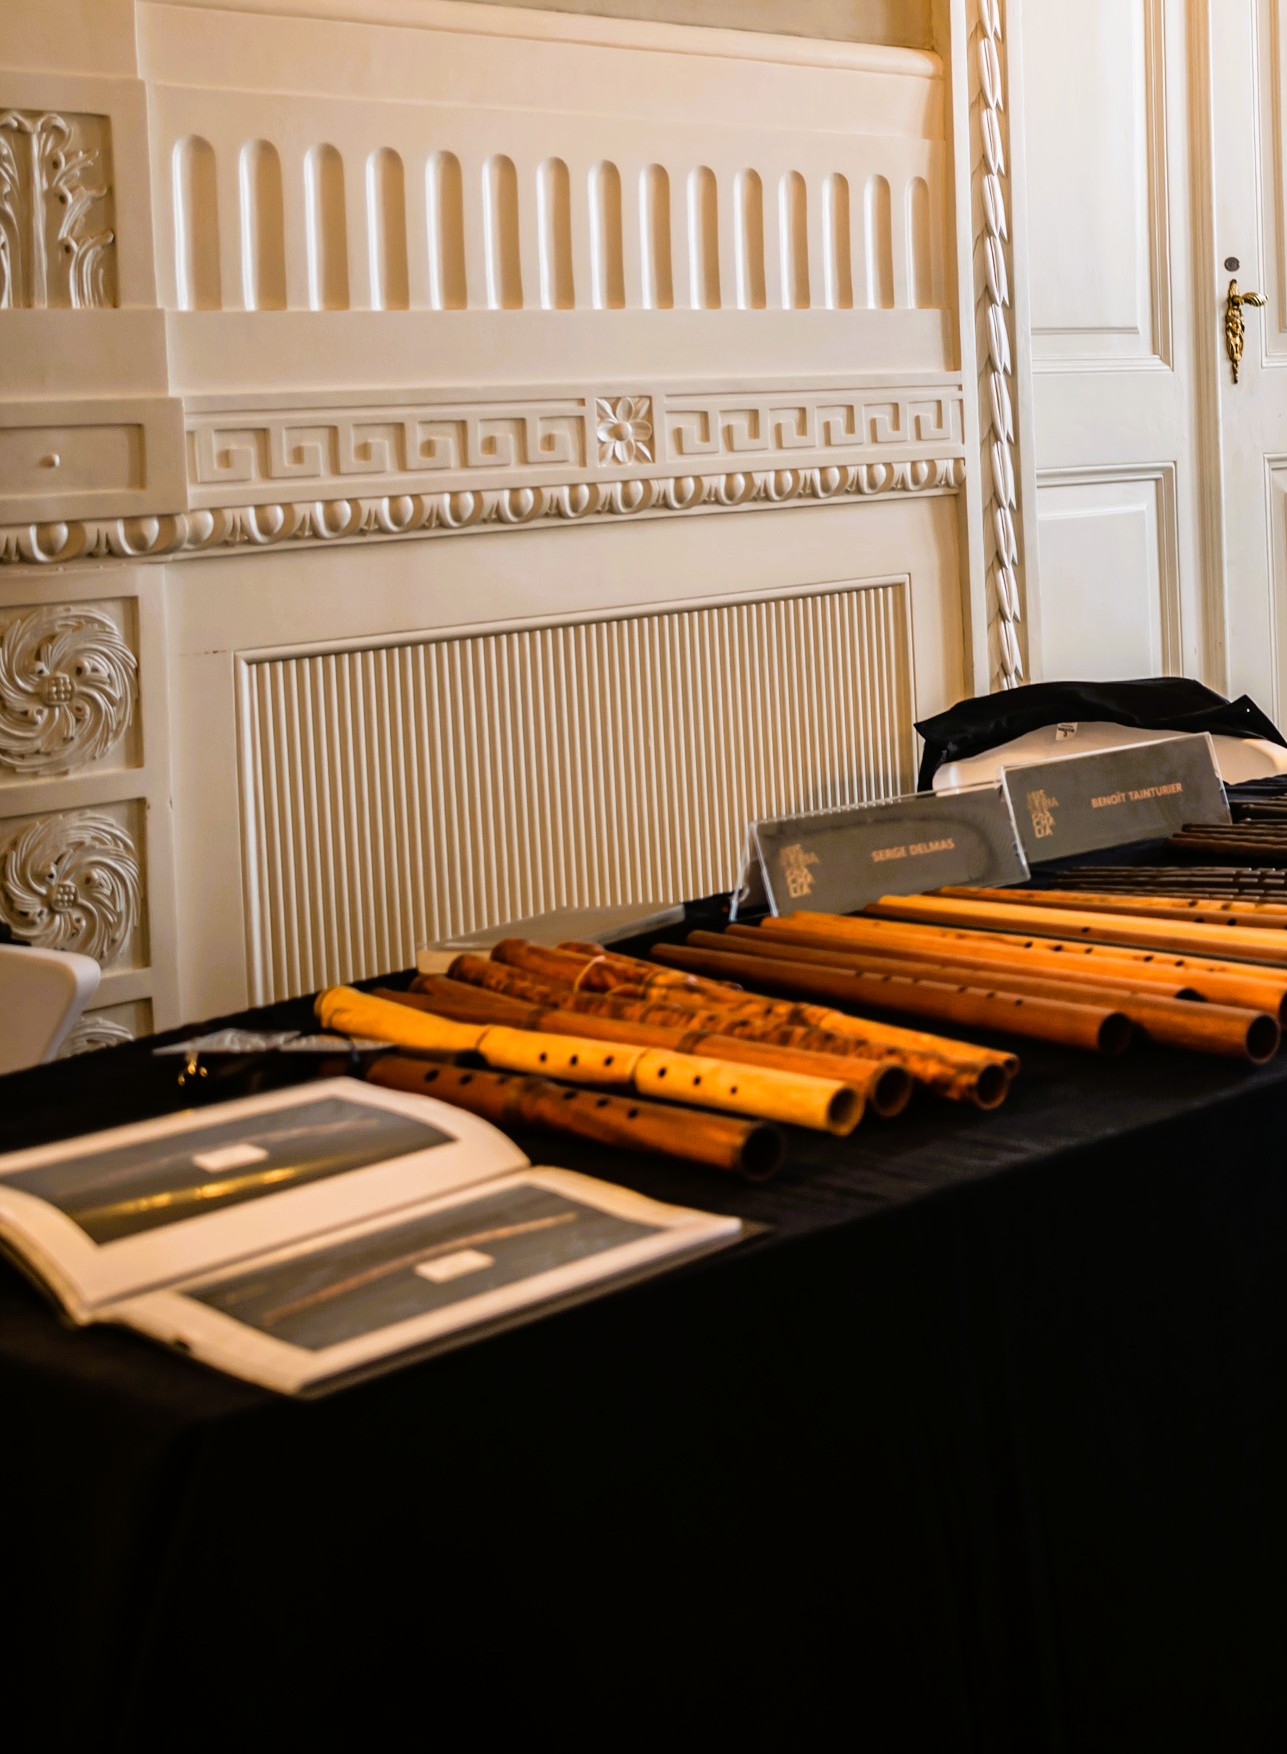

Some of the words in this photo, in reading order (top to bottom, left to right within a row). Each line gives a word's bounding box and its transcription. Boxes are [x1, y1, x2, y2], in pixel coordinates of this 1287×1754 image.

[1129, 782, 1184, 801] TAINTURIER
[871, 846, 907, 863] SERGE
[909, 838, 956, 857] DELMAS
